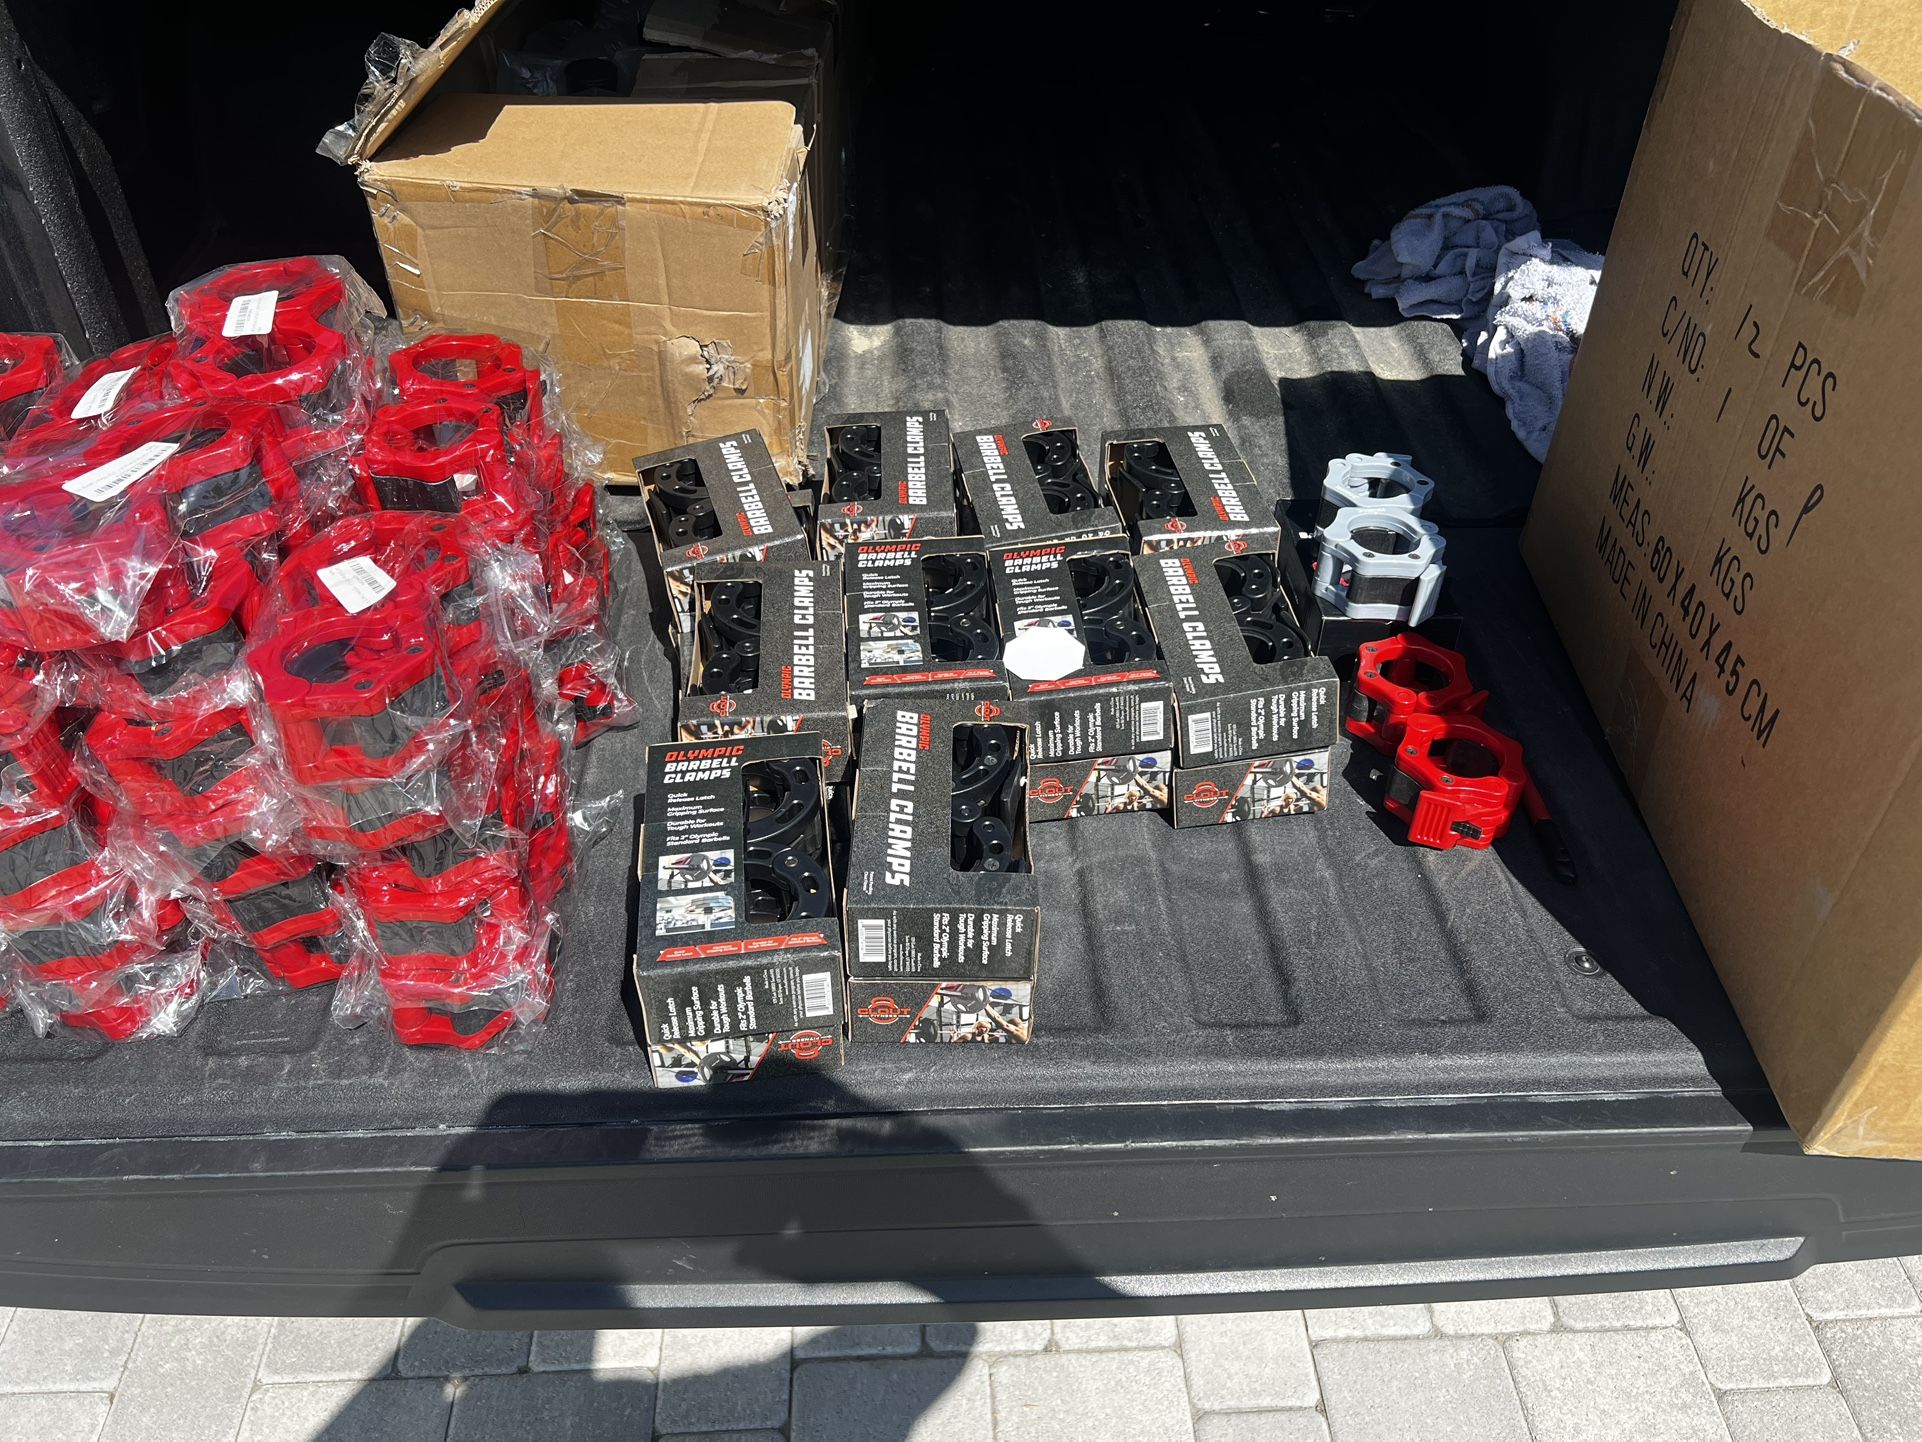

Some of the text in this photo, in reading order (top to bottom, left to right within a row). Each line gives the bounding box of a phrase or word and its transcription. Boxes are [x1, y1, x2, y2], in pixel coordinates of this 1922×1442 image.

[1682, 232, 1836, 422] QTY: 12 PCS
[1662, 296, 1706, 382] C/NO:
[1758, 414, 1794, 469] OF
[906, 416, 927, 504] BARBELL CLAMPS
[1187, 431, 1223, 470] CLAMPS
[1642, 353, 1779, 554] N.W.: KGS
[720, 440, 773, 534] BARBELL CLAMPS
[976, 435, 1025, 530] BARBELL CLAMPS
[1209, 472, 1250, 521] BARBELL
[1626, 413, 1753, 616] G.W.: KGS
[858, 544, 921, 553] OLYMPIC
[858, 551, 917, 560] BARBELL
[858, 559, 912, 567] CLAMPS
[1003, 546, 1066, 559] OLYMPIC
[1005, 554, 1063, 566] BARBELL
[1006, 561, 1059, 573] CLAMPS
[1180, 558, 1199, 585] OLYMPIC
[1159, 559, 1199, 618] BARBELL
[1182, 622, 1224, 683] CLAMPS
[1596, 516, 1697, 713] MADE IN CHINA
[1609, 464, 1650, 558] MEAS:
[1740, 679, 1780, 748] CM
[794, 570, 815, 700] BARBELL CLAMPS
[781, 665, 792, 699] OLYMPIC
[919, 713, 931, 752] OLYMPIC
[664, 757, 739, 772] BARBELL
[665, 745, 744, 761] OLYMPIC
[892, 711, 918, 793] BARBELL
[664, 769, 731, 783] CLAMPS
[1029, 786, 1073, 795] CLOUT
[885, 799, 913, 887] CLAMPS
[958, 913, 966, 934] Tough
[967, 914, 975, 938] Durable
[981, 914, 990, 941] Gripping
[991, 914, 999, 945] Maximum
[1015, 915, 1023, 933] Quick
[692, 987, 706, 1036] Gripping Surface
[718, 984, 731, 1032] Tough Workouts
[735, 987, 745, 1011] Olympic
[743, 976, 756, 1030] Standard Barbells
[663, 1023, 671, 1040] Quick
[667, 997, 680, 1039] Release Latch
[686, 1007, 696, 1036] Maximum
[712, 1011, 721, 1033] Durable
[739, 1020, 748, 1031] Fits
